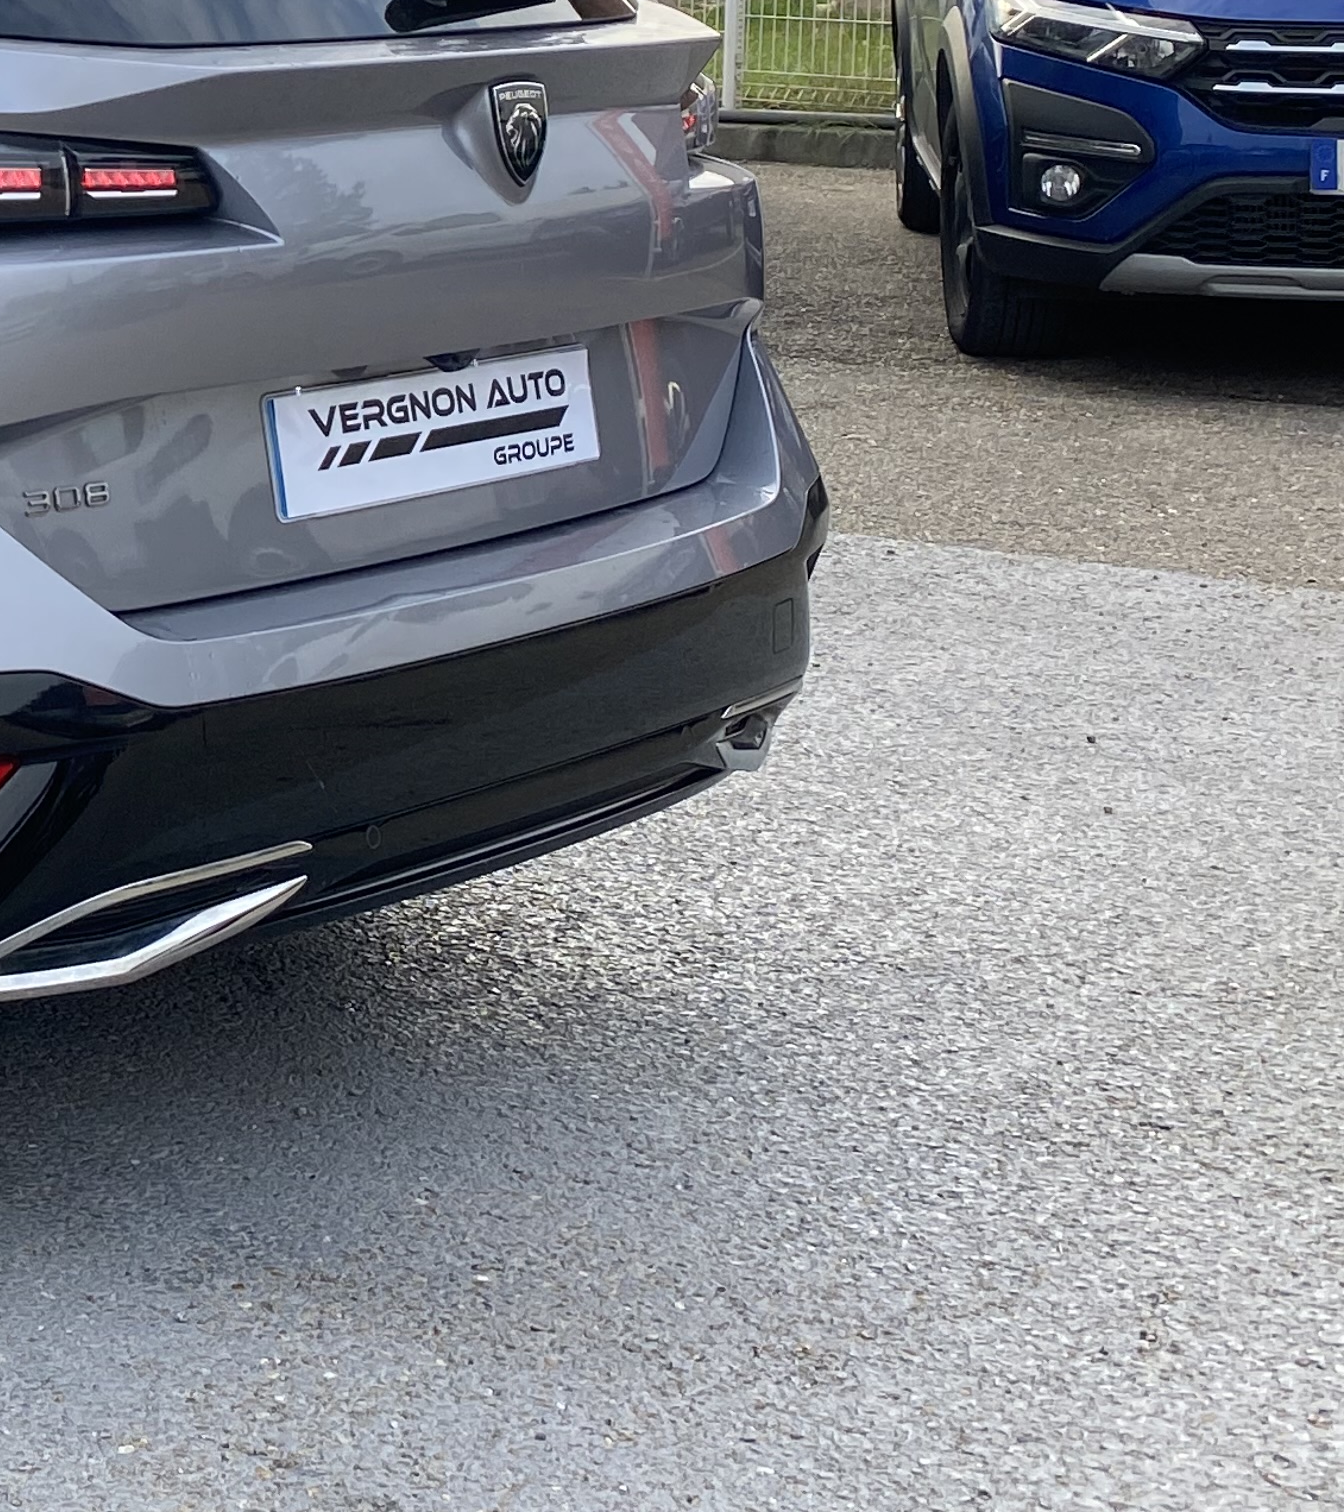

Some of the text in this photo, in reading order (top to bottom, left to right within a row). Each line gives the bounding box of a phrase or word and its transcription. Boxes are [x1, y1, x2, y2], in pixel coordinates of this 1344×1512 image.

[1320, 169, 1330, 181] F
[308, 368, 566, 437] VERGNON AUTO
[494, 433, 575, 466] GROUPE
[22, 481, 110, 517] 308
